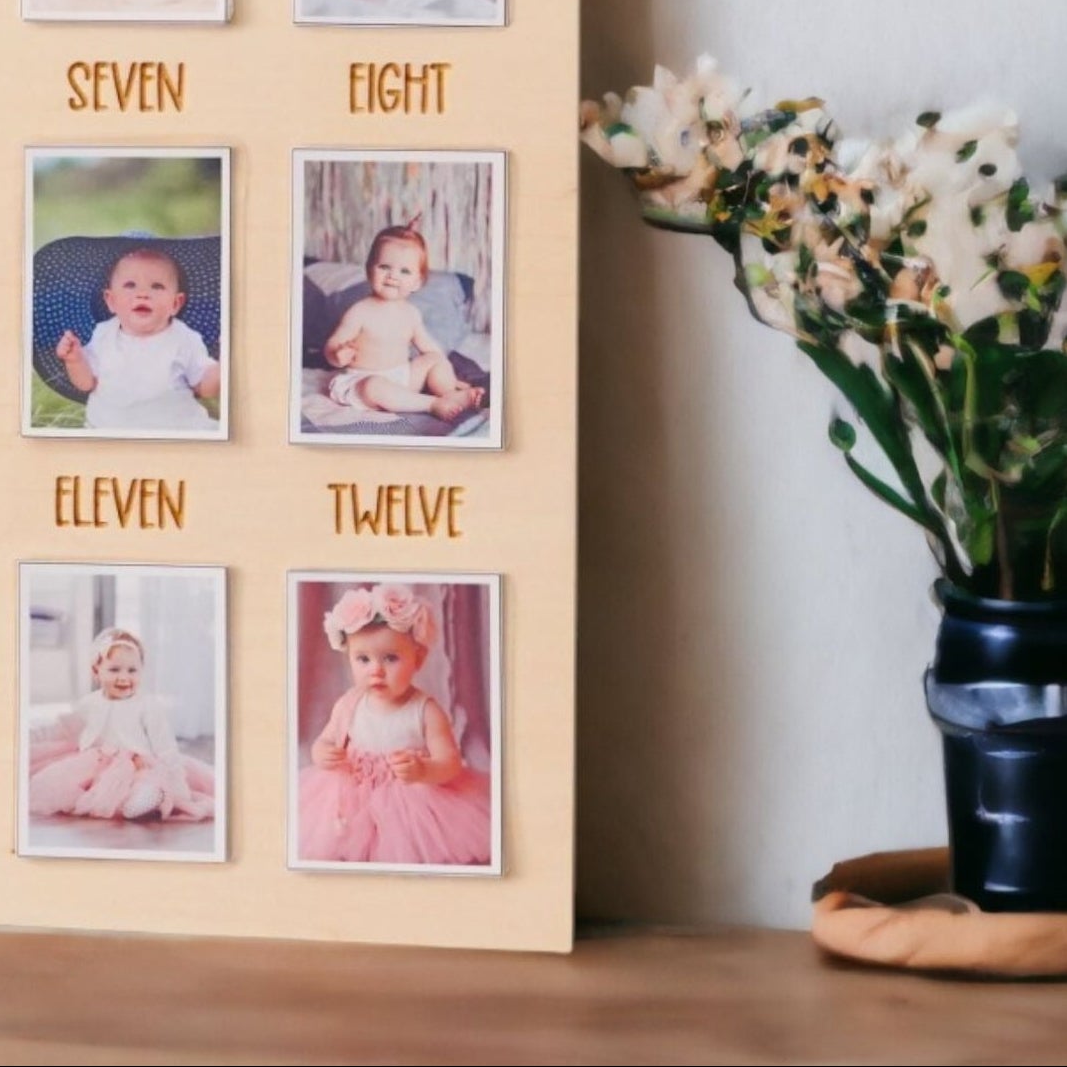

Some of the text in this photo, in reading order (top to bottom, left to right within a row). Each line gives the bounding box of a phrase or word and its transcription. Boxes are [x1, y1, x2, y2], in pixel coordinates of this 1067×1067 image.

[66, 60, 185, 113] SEVEN
[348, 61, 452, 115] EIGHT
[54, 475, 186, 530] ELEVEN
[326, 482, 465, 539] TWELVE
